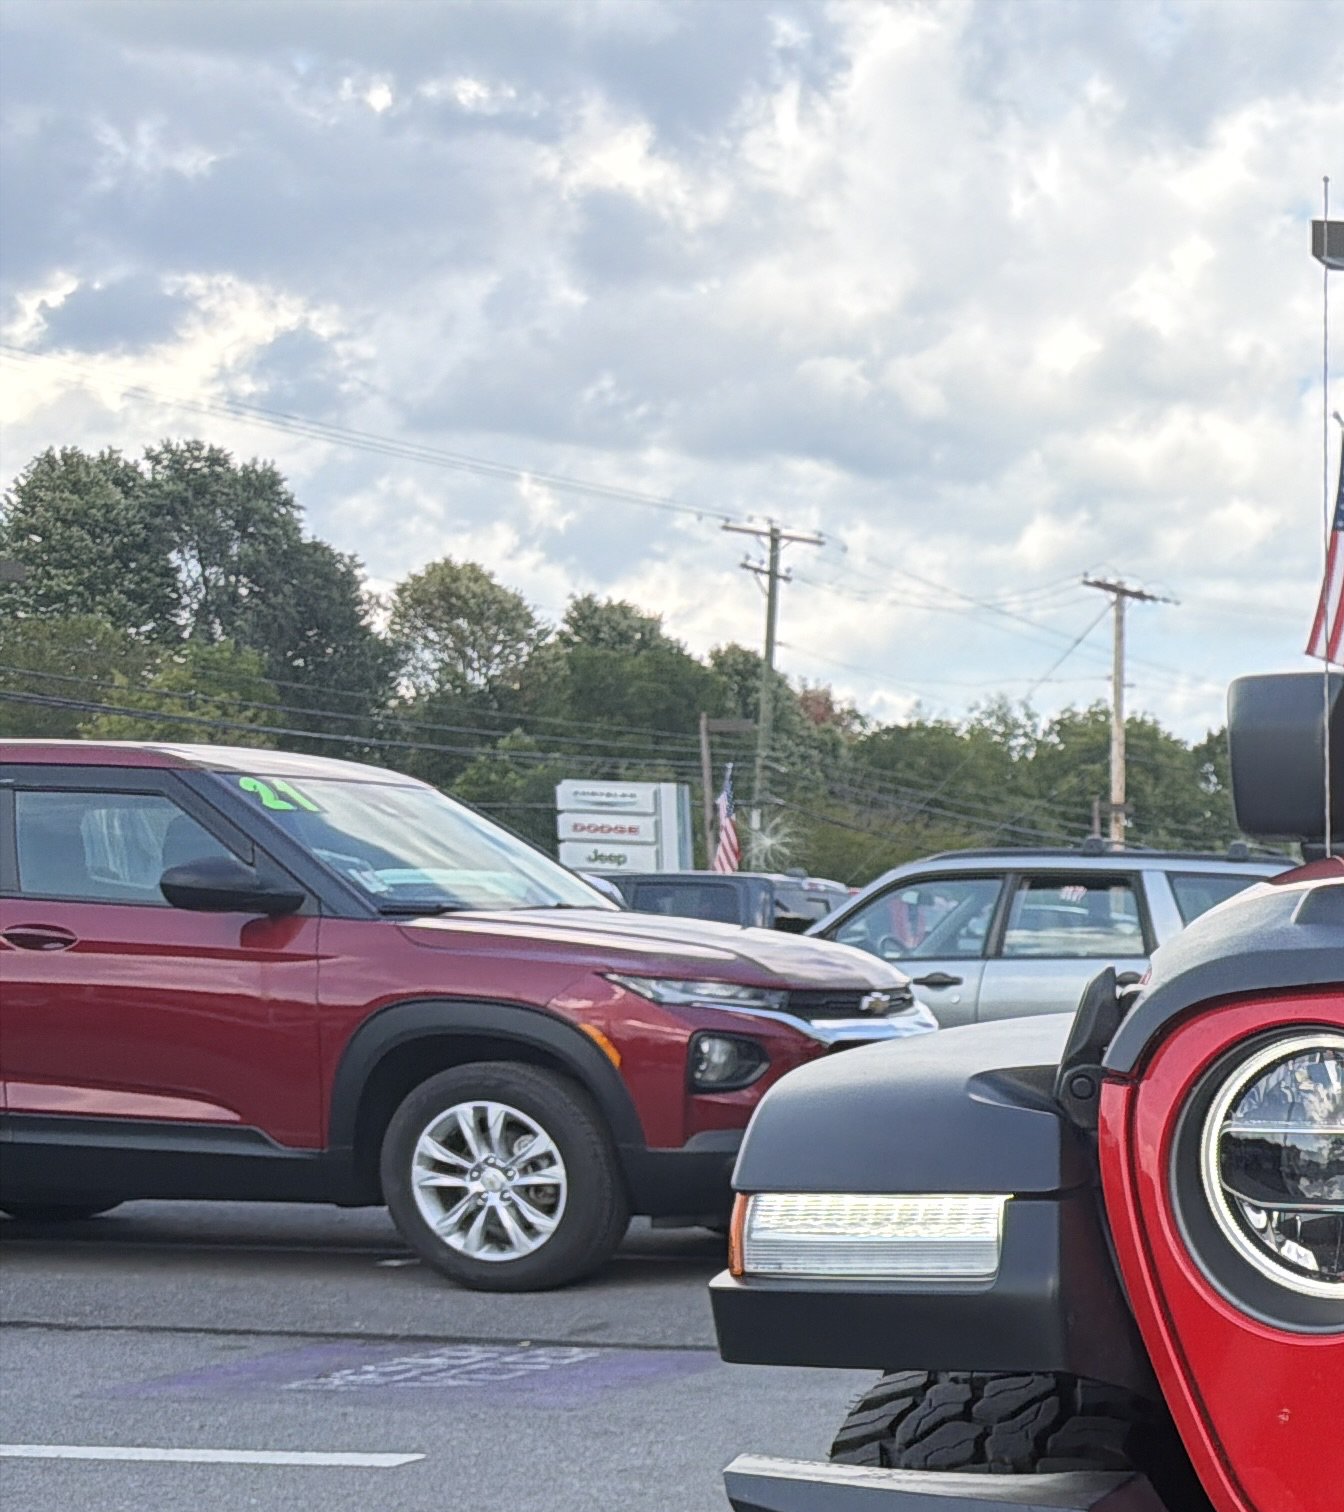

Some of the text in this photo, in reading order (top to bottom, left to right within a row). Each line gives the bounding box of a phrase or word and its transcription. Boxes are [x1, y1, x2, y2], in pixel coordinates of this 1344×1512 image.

[239, 776, 321, 812] 21
[571, 822, 640, 836] DODGE
[586, 848, 628, 866] Jeep
